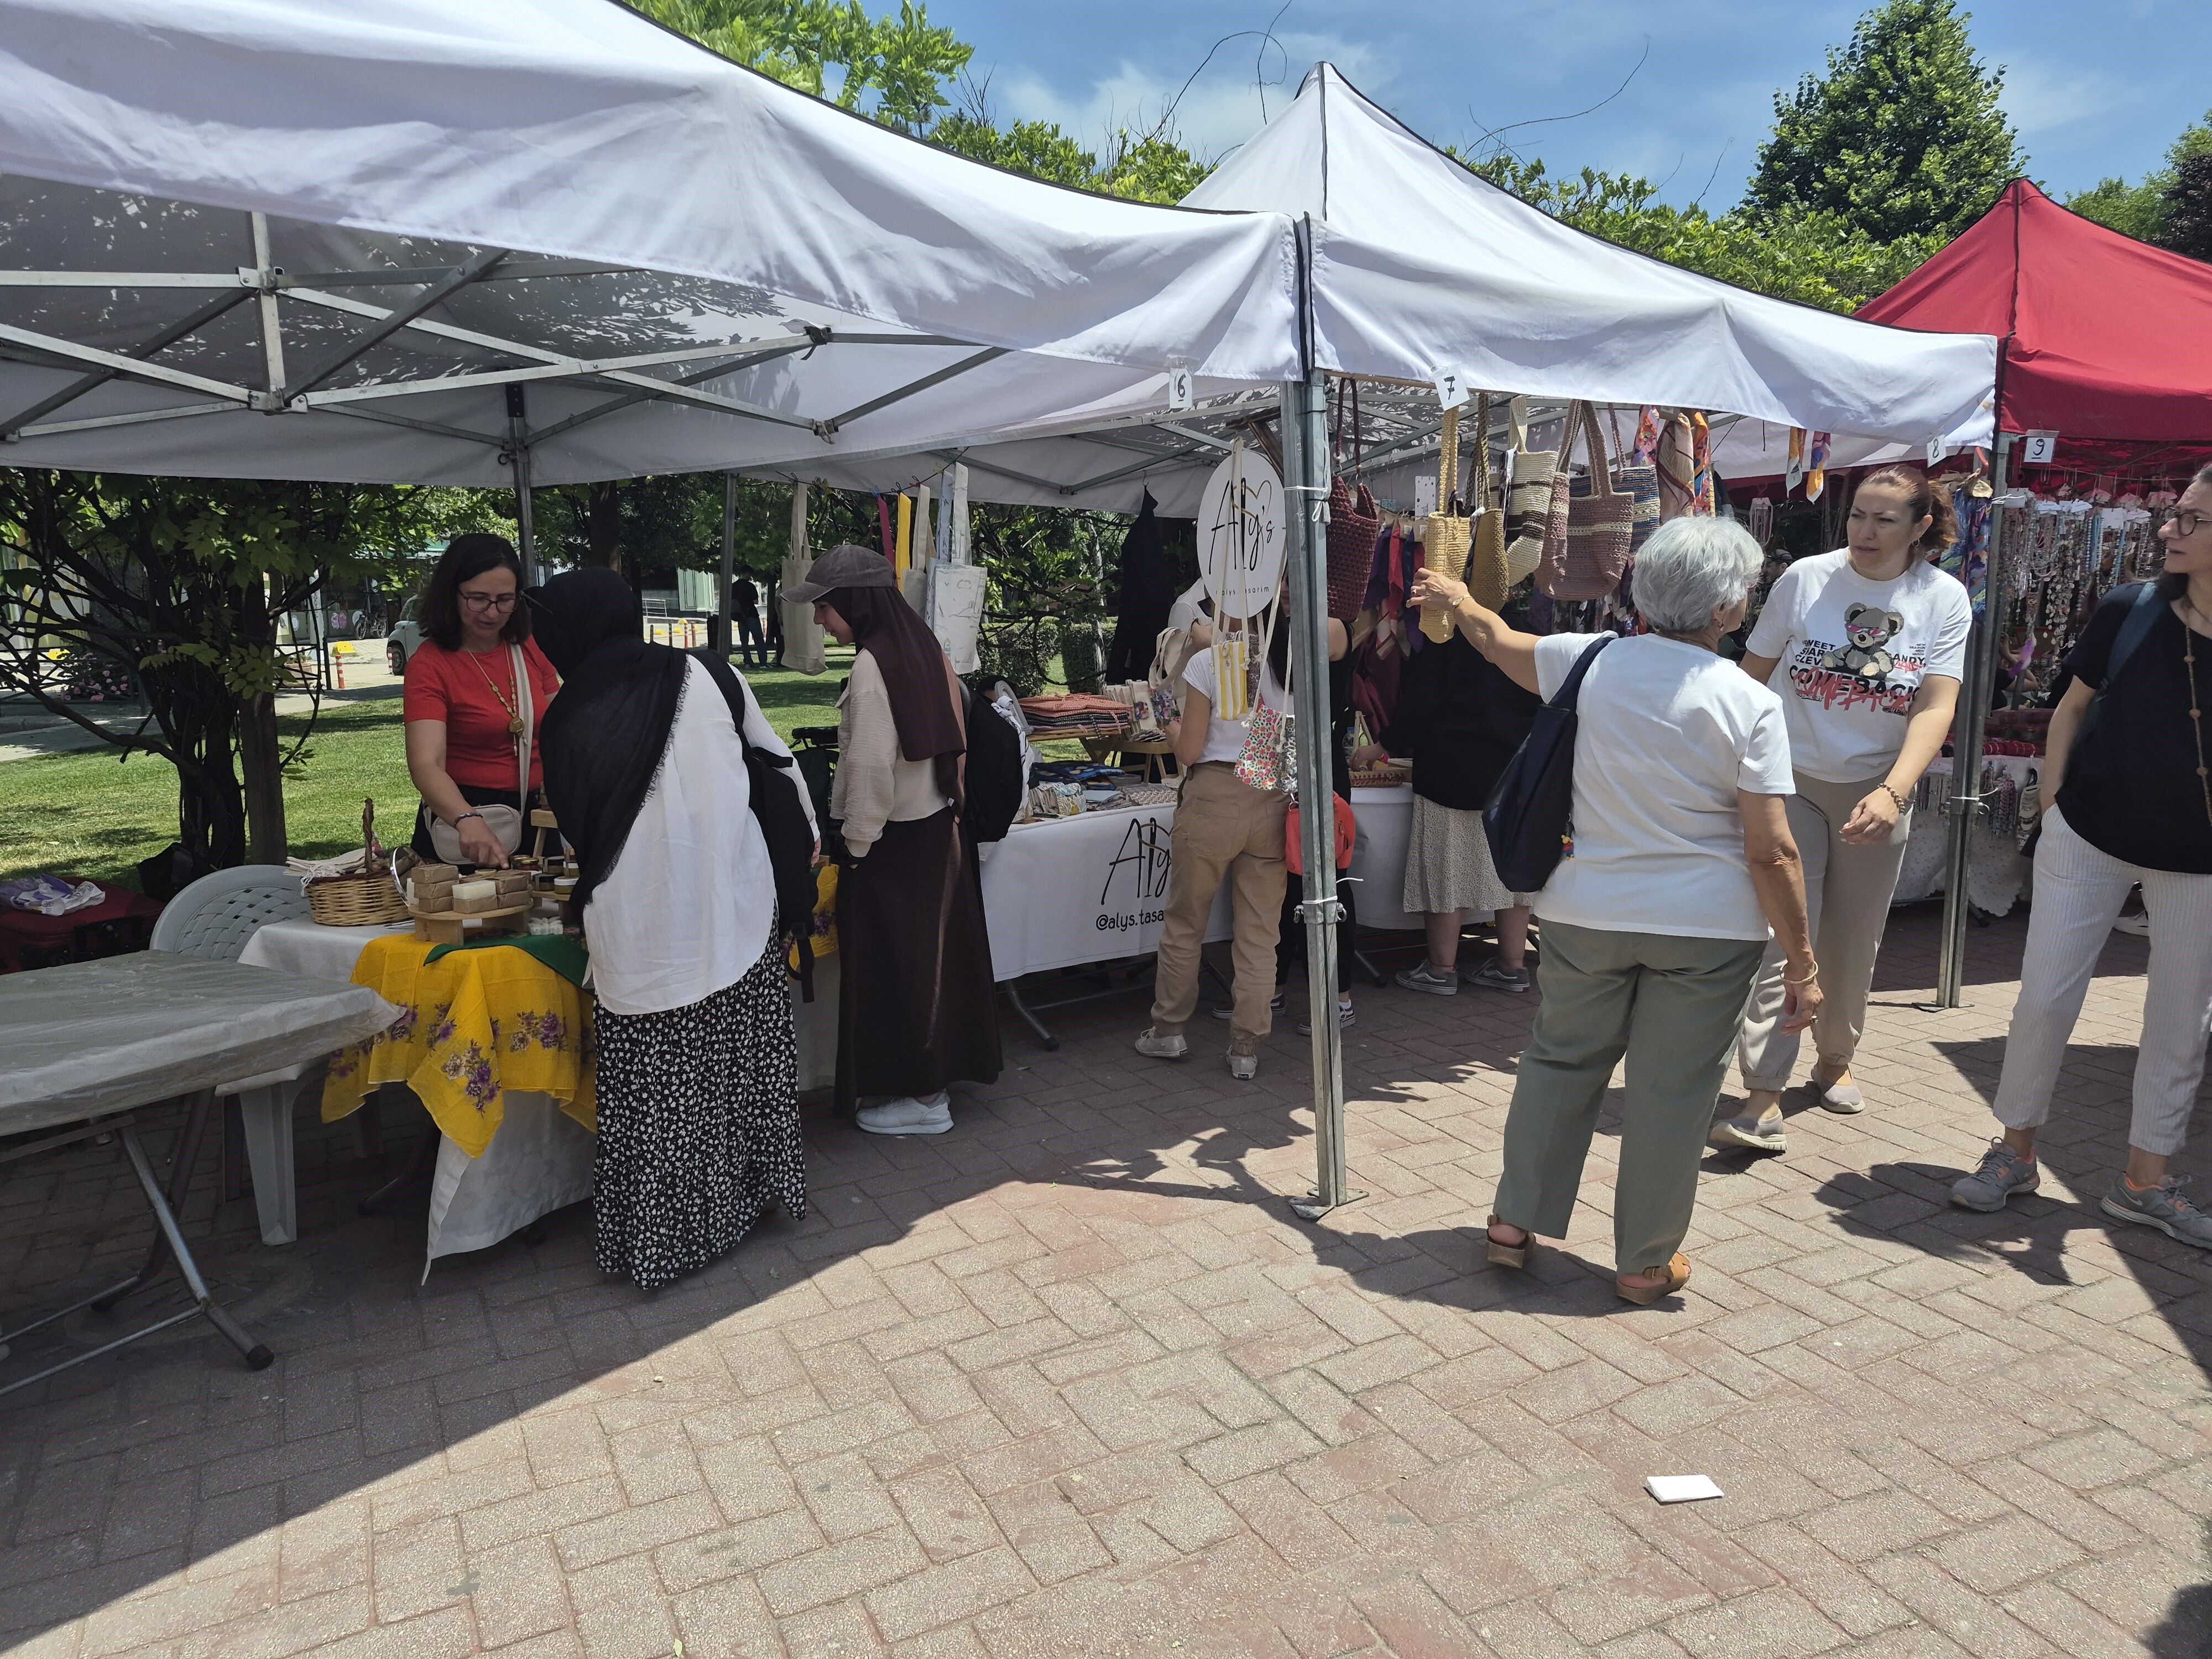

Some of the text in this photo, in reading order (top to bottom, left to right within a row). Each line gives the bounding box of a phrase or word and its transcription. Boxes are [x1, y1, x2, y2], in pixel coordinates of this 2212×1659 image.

[1177, 373, 1186, 398] 6
[1443, 375, 1455, 400] 7
[1932, 438, 1939, 459] 8
[2033, 438, 2045, 456] 9
[1100, 817, 1172, 905] Aly
[1095, 909, 1164, 932] @alys.tasa
